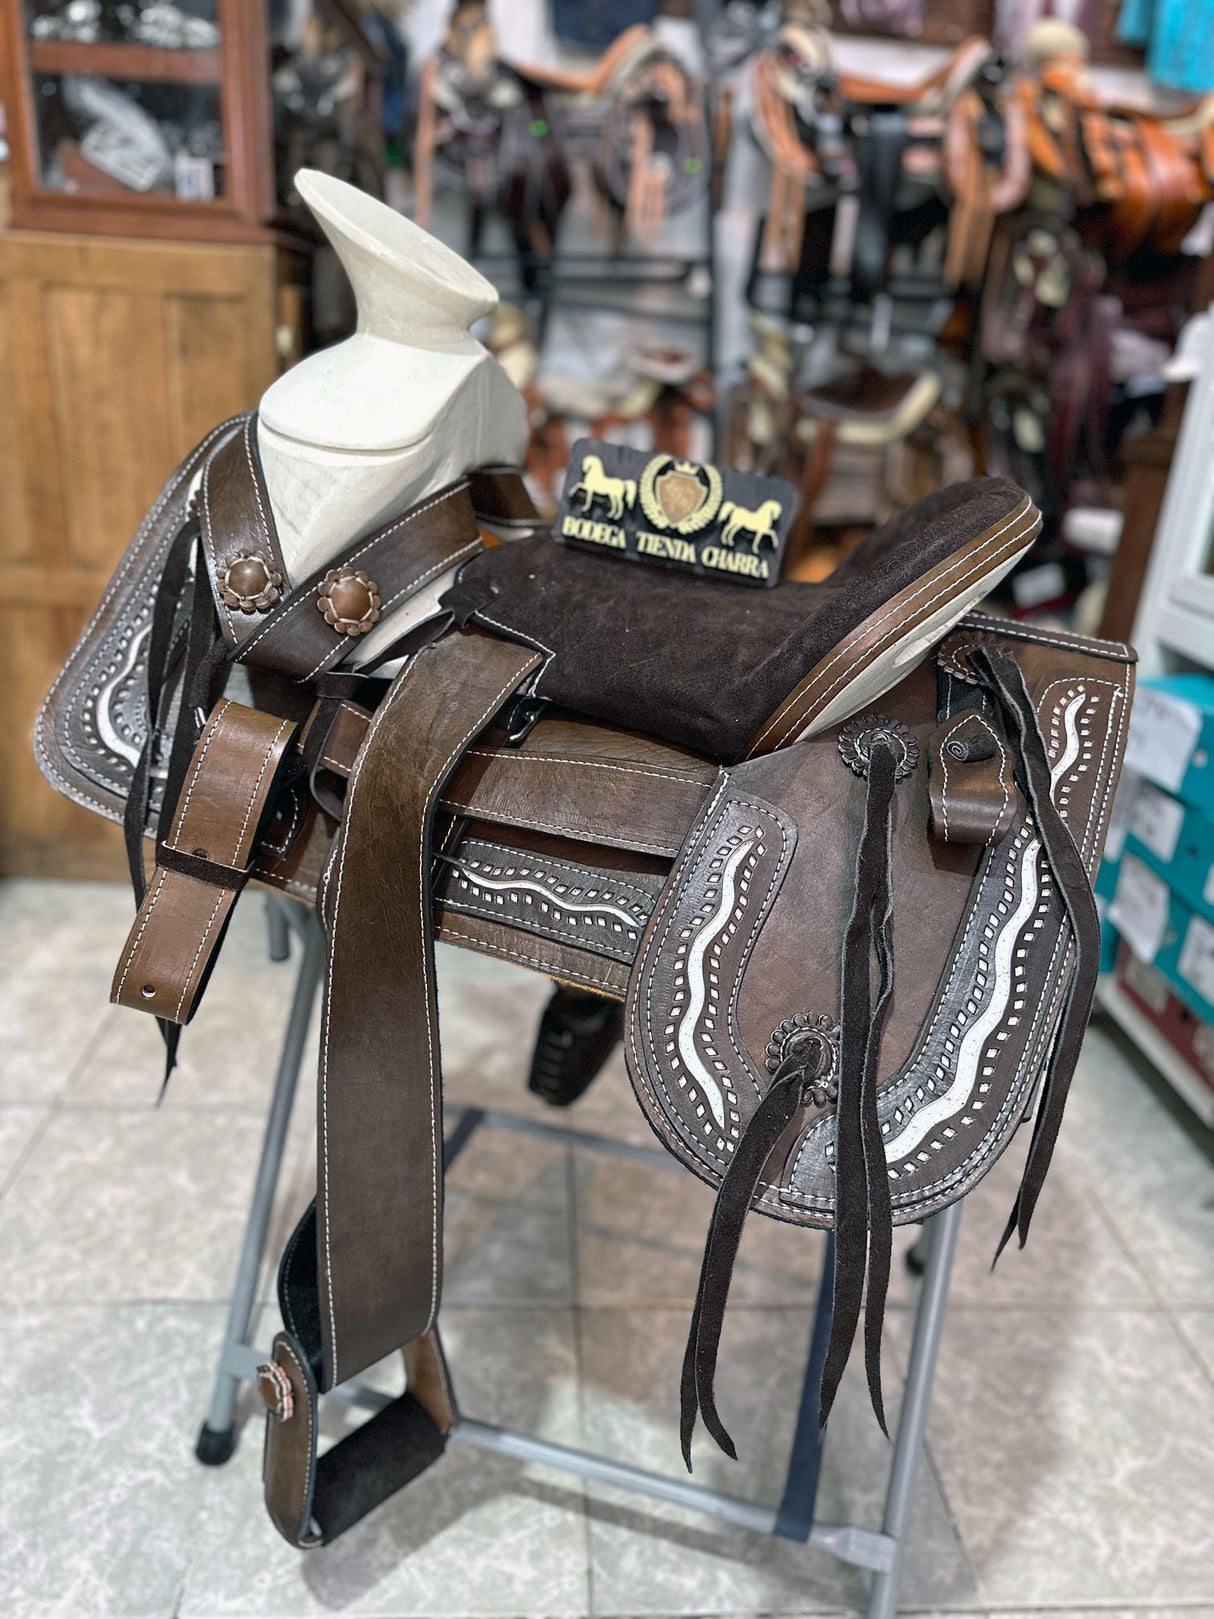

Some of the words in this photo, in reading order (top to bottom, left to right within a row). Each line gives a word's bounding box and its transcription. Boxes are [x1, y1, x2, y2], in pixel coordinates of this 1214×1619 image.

[562, 515, 627, 549] BODEGA
[636, 531, 697, 564] TIENDA
[701, 546, 769, 579] CHARRA
